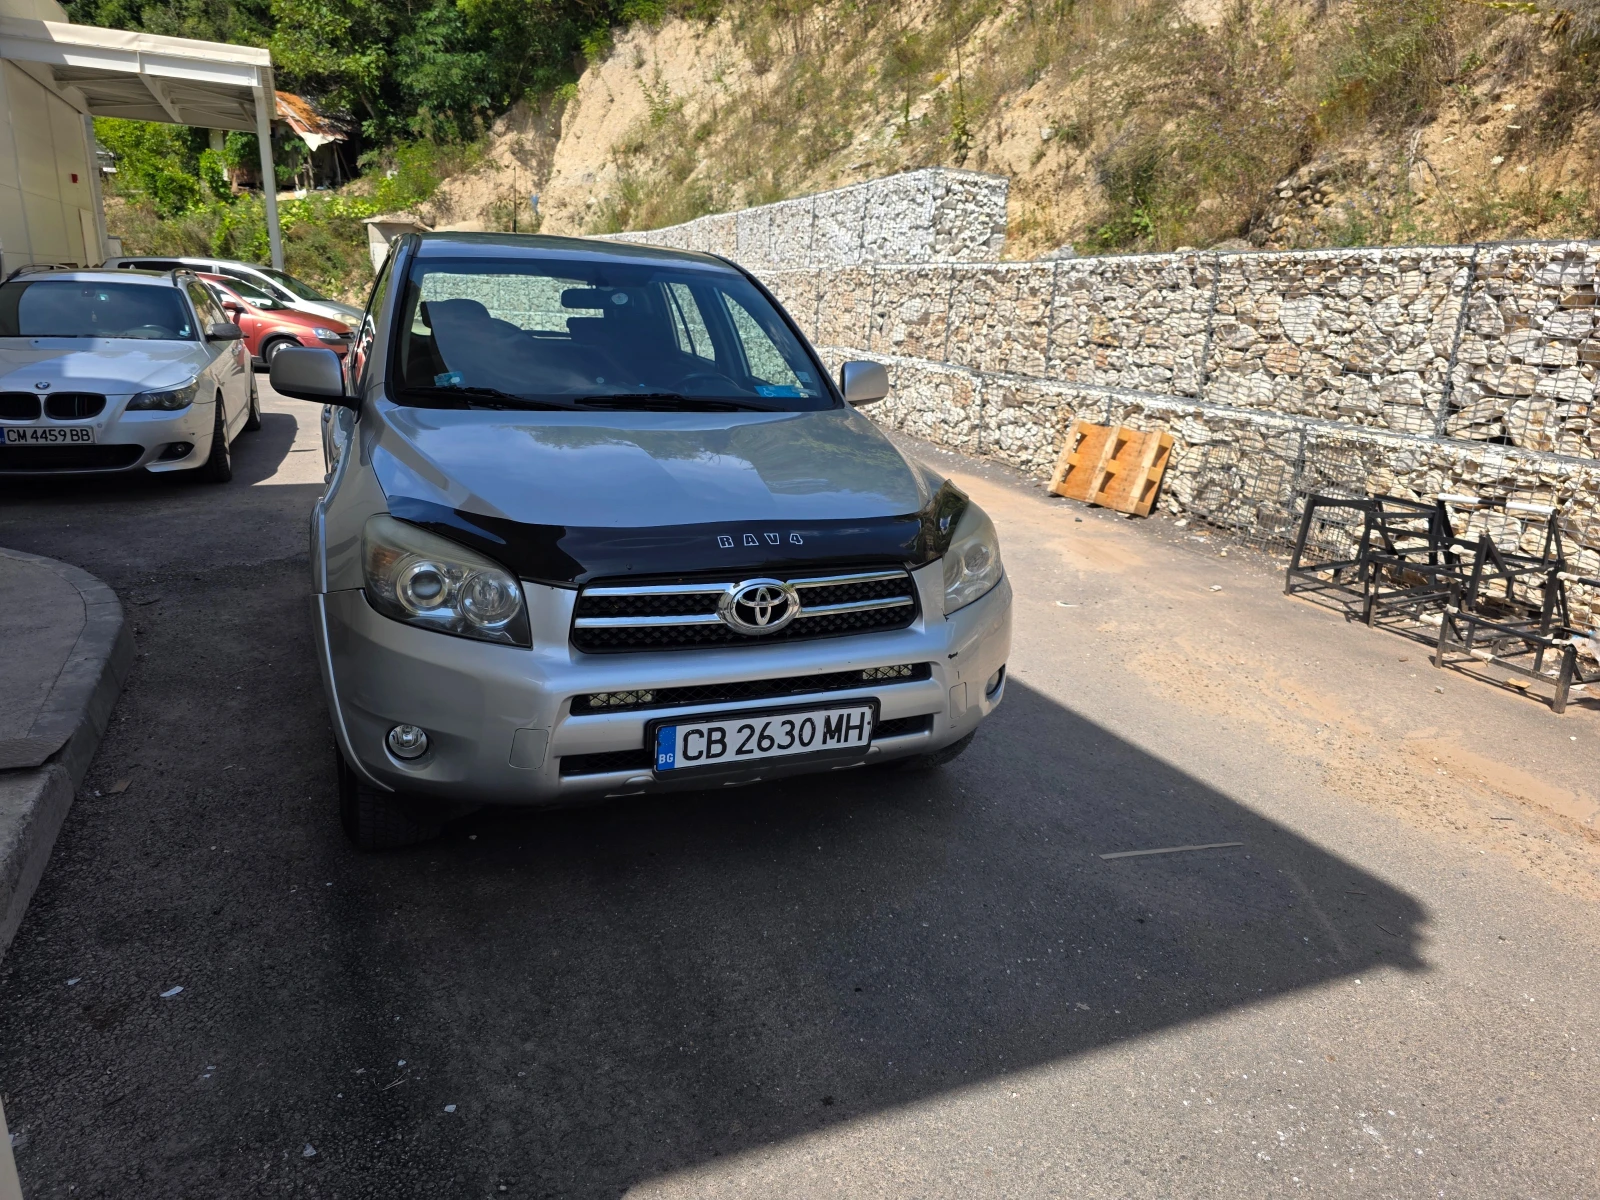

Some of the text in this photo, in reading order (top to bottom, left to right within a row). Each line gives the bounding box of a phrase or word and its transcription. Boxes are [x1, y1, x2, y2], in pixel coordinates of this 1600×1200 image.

[7, 429, 28, 443] CM
[31, 429, 67, 442] 4459
[70, 429, 91, 442] BB
[682, 711, 866, 761] CB 2630 MH
[658, 753, 674, 764] BG
